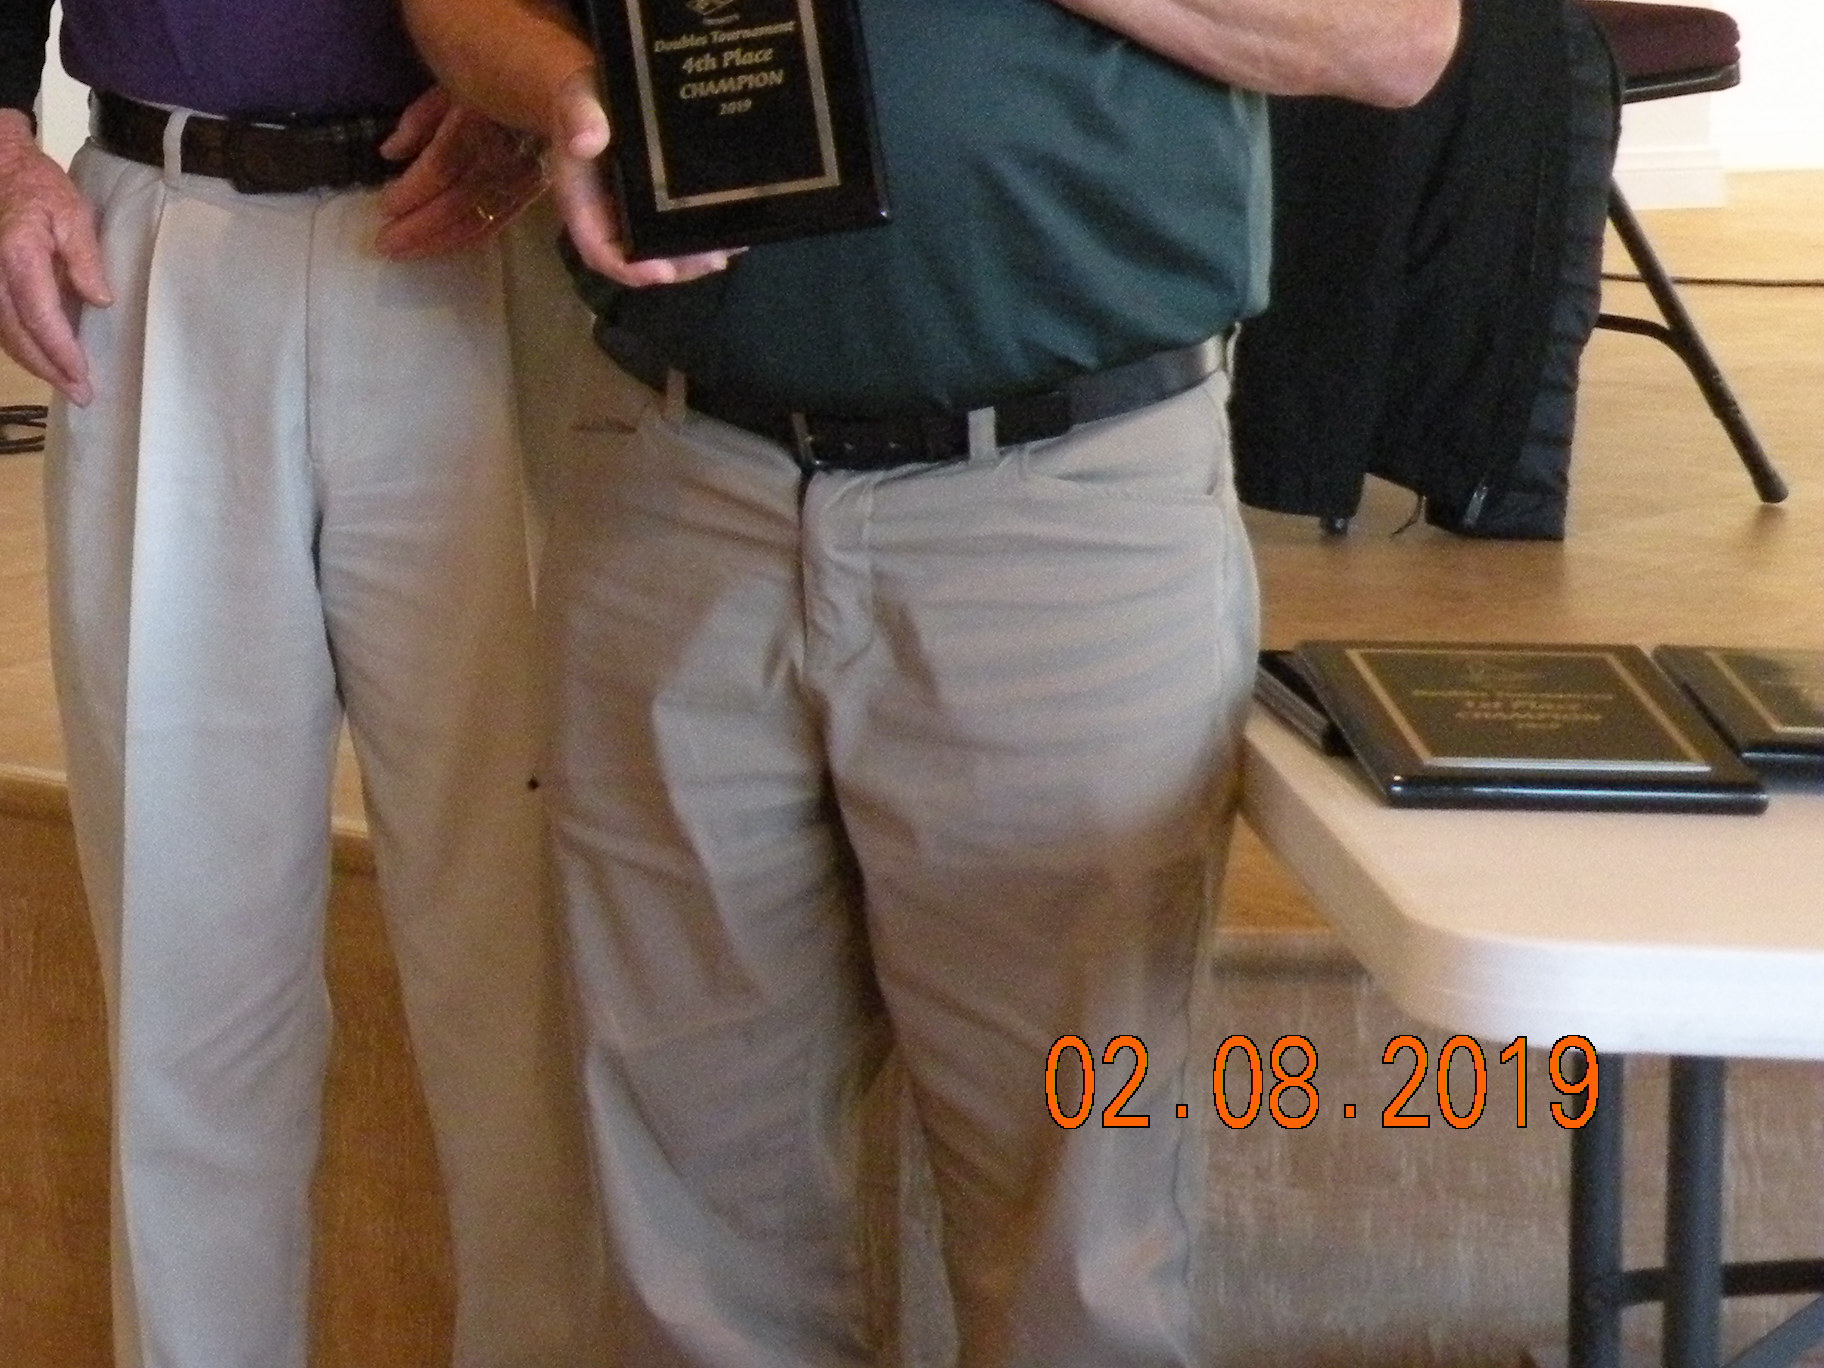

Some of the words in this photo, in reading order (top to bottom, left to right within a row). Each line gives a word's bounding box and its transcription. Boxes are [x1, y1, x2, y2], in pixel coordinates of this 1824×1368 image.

[681, 52, 718, 74] 4th
[722, 47, 774, 68] Place
[679, 69, 784, 100] CHAMPION
